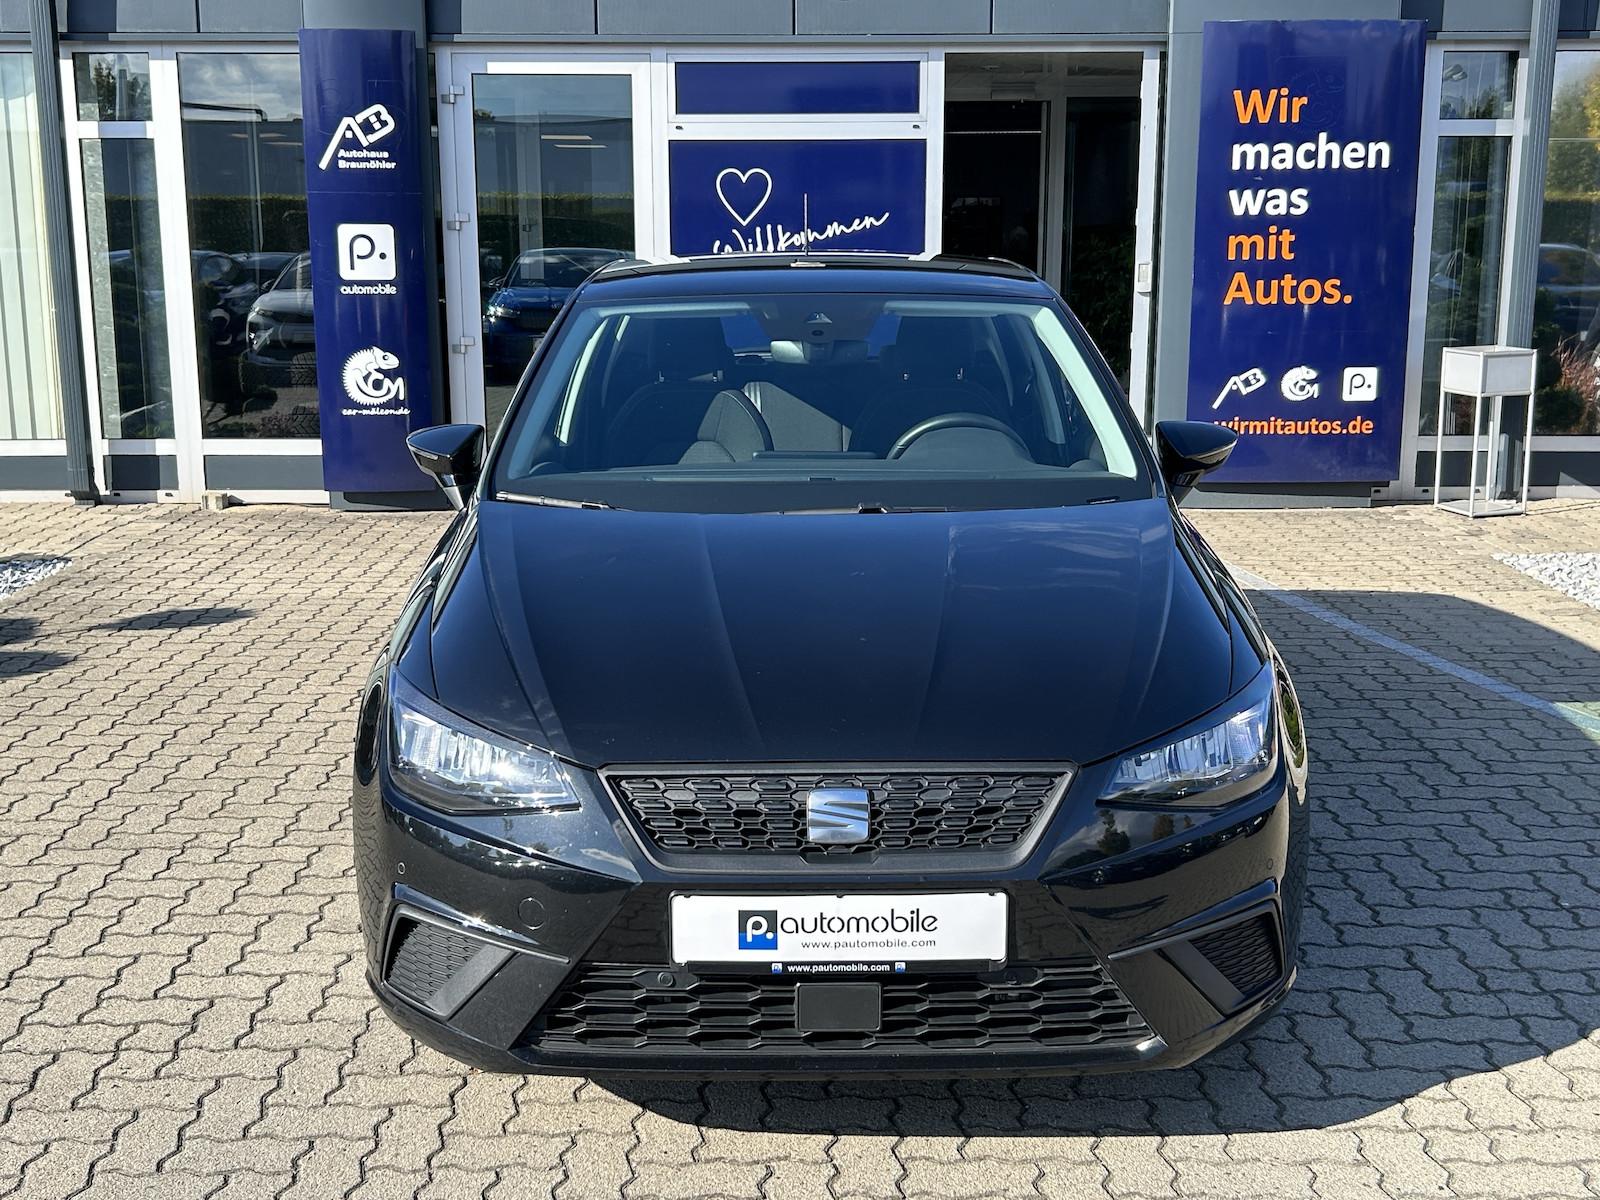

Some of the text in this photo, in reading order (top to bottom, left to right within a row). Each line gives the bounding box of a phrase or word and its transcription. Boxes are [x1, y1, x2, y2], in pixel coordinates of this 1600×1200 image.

[1232, 87, 1308, 124] Wir
[337, 148, 389, 159] Autohaus
[337, 159, 396, 169] Braunöhler
[1231, 131, 1391, 171] machen
[1228, 186, 1310, 216] was
[1227, 225, 1296, 261] mit
[340, 283, 397, 295] automobile
[1223, 271, 1353, 305] Autos.
[780, 908, 938, 935] automobile
[800, 938, 937, 950] www.pautomobile.com
[787, 963, 891, 974] www.pautomobile.com
